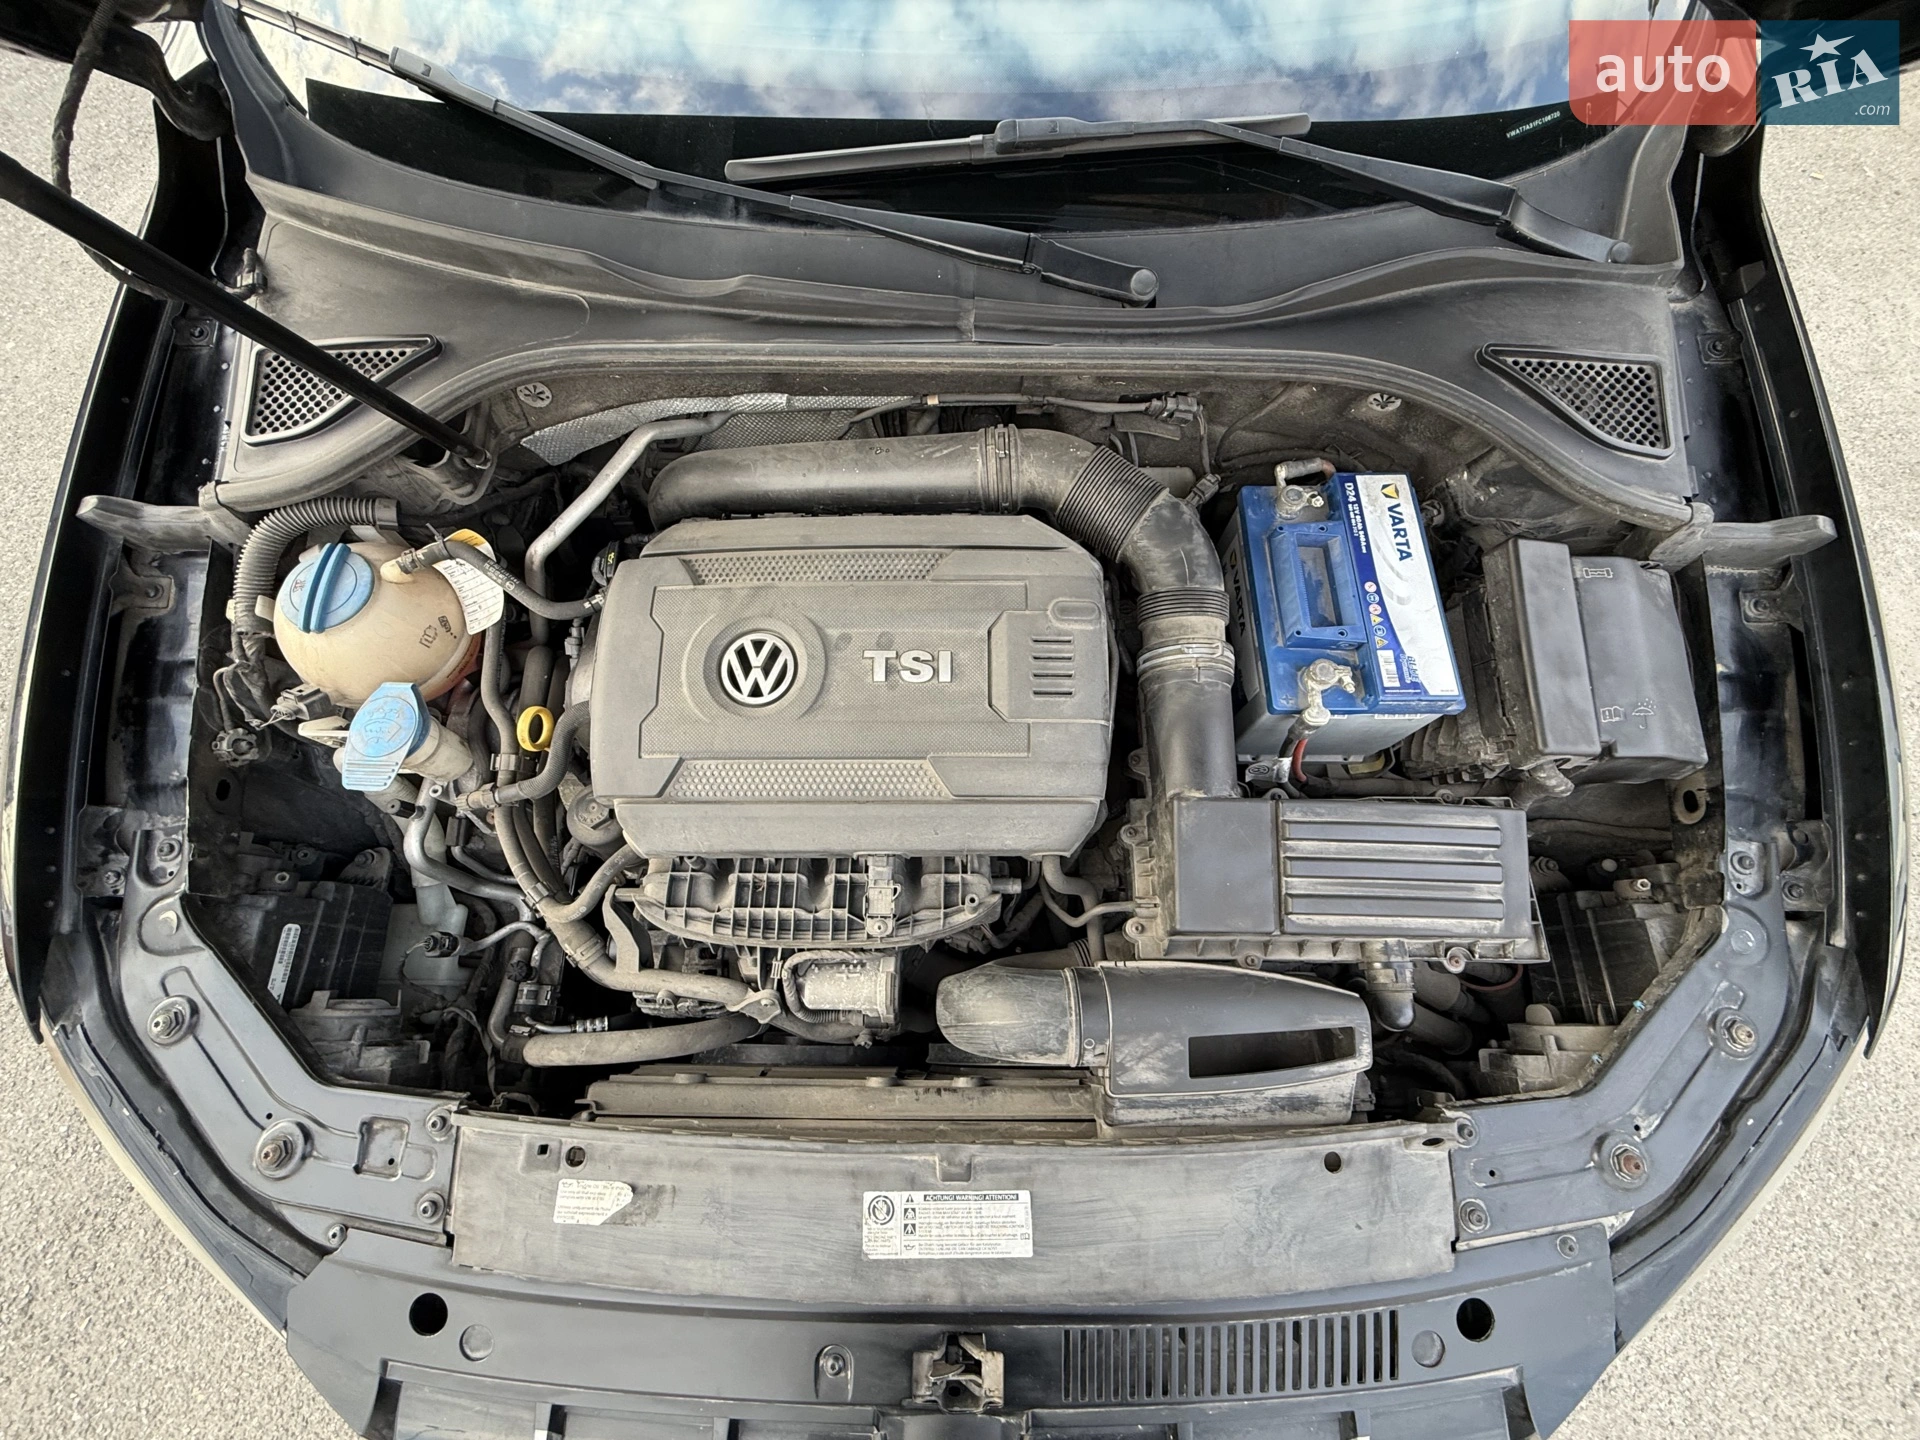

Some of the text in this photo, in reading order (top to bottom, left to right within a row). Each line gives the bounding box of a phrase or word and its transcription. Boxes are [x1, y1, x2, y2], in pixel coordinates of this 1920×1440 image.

[1344, 482, 1357, 503] D24
[1387, 502, 1413, 562] VARTA
[1232, 570, 1246, 638] VARTA
[863, 650, 953, 683] TSI
